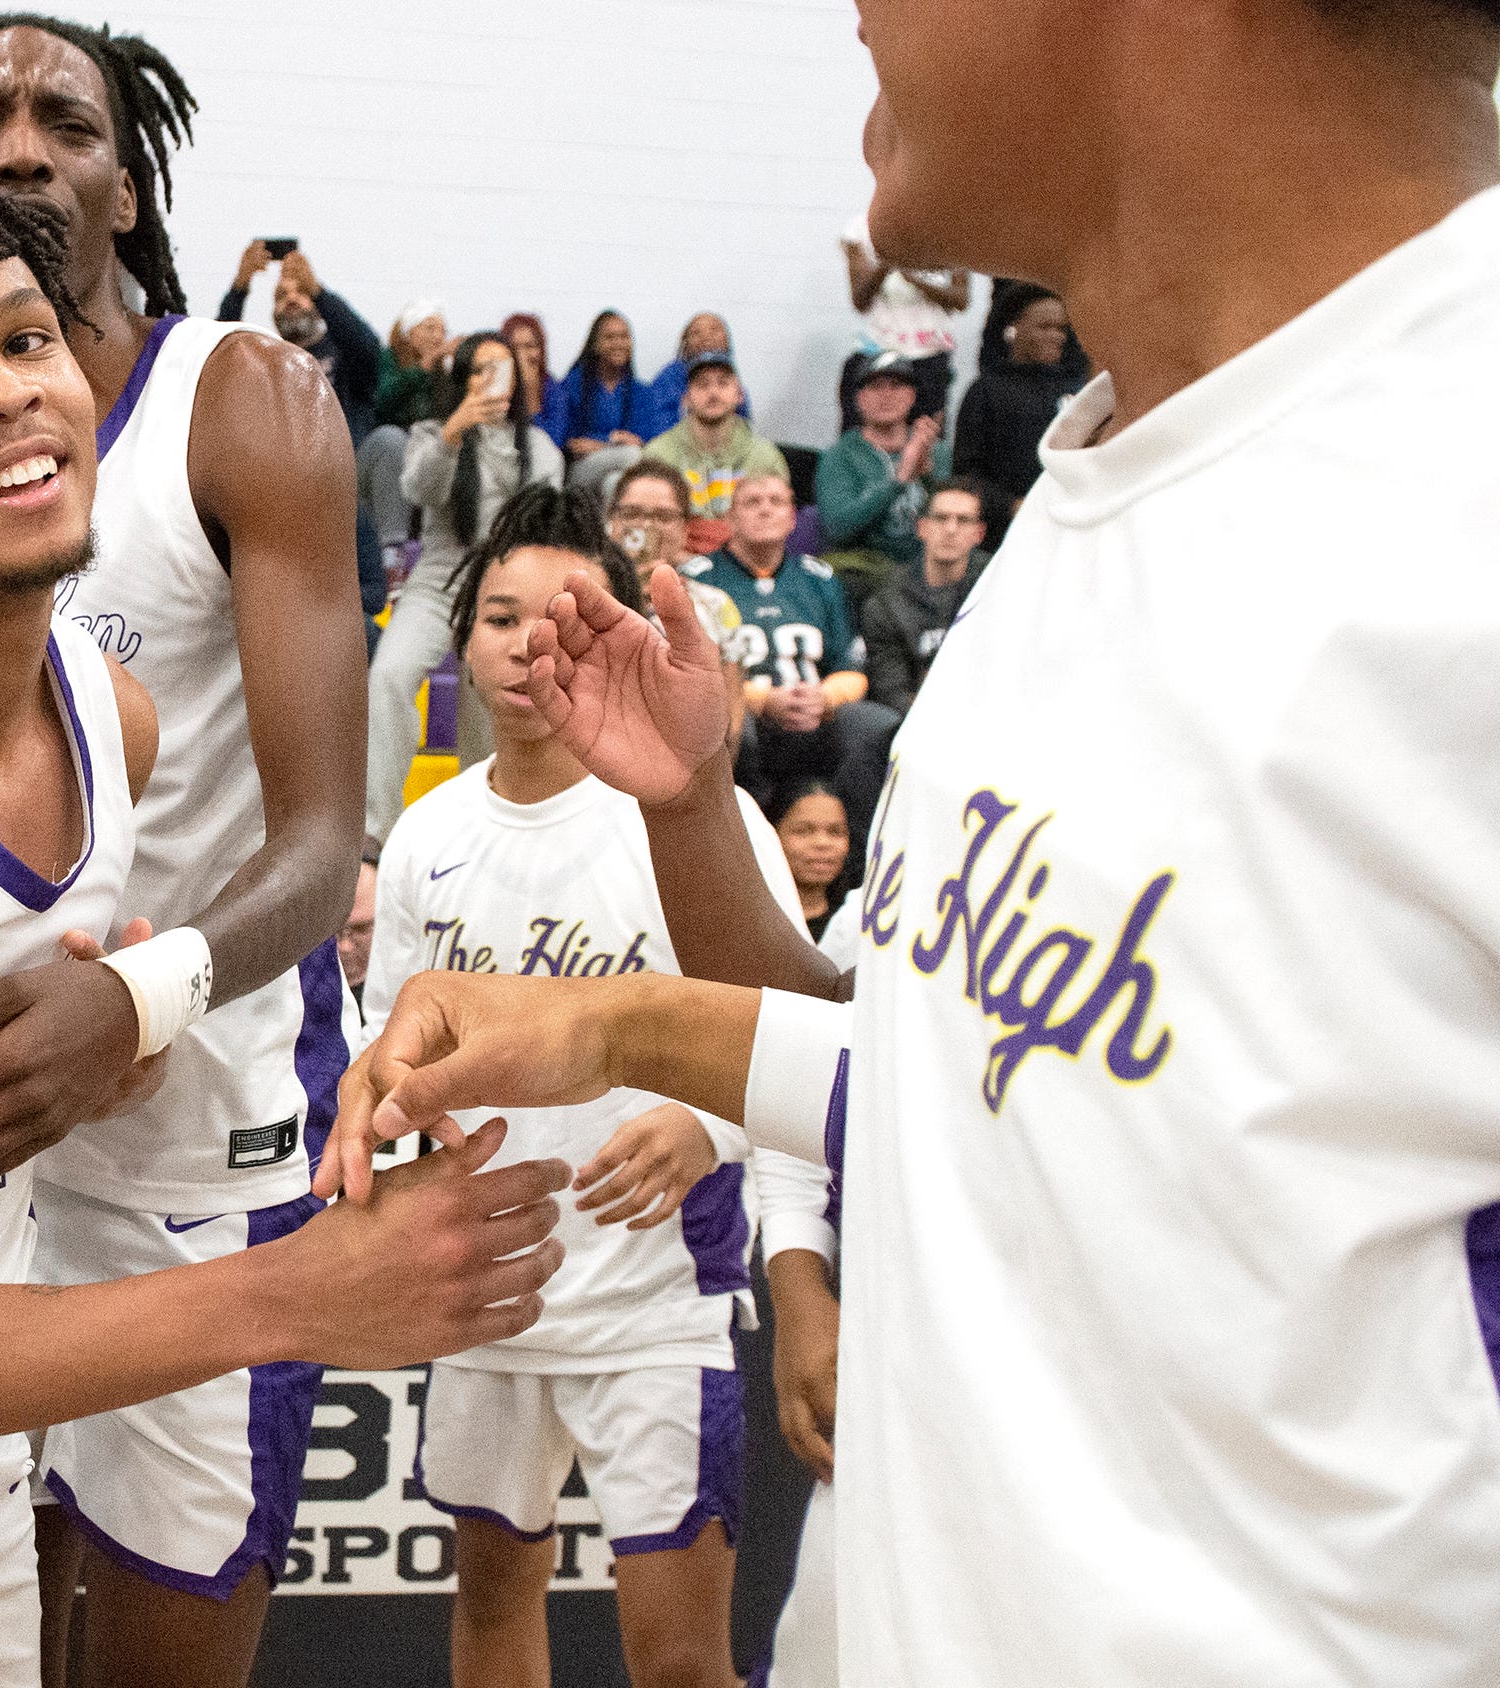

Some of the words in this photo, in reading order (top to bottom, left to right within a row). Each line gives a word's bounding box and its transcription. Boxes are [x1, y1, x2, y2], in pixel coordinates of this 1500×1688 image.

[424, 917, 497, 973] The
[862, 753, 904, 946] he
[909, 788, 1174, 1116] High
[284, 1132, 292, 1147] L
[281, 1523, 617, 1583] SPOT
